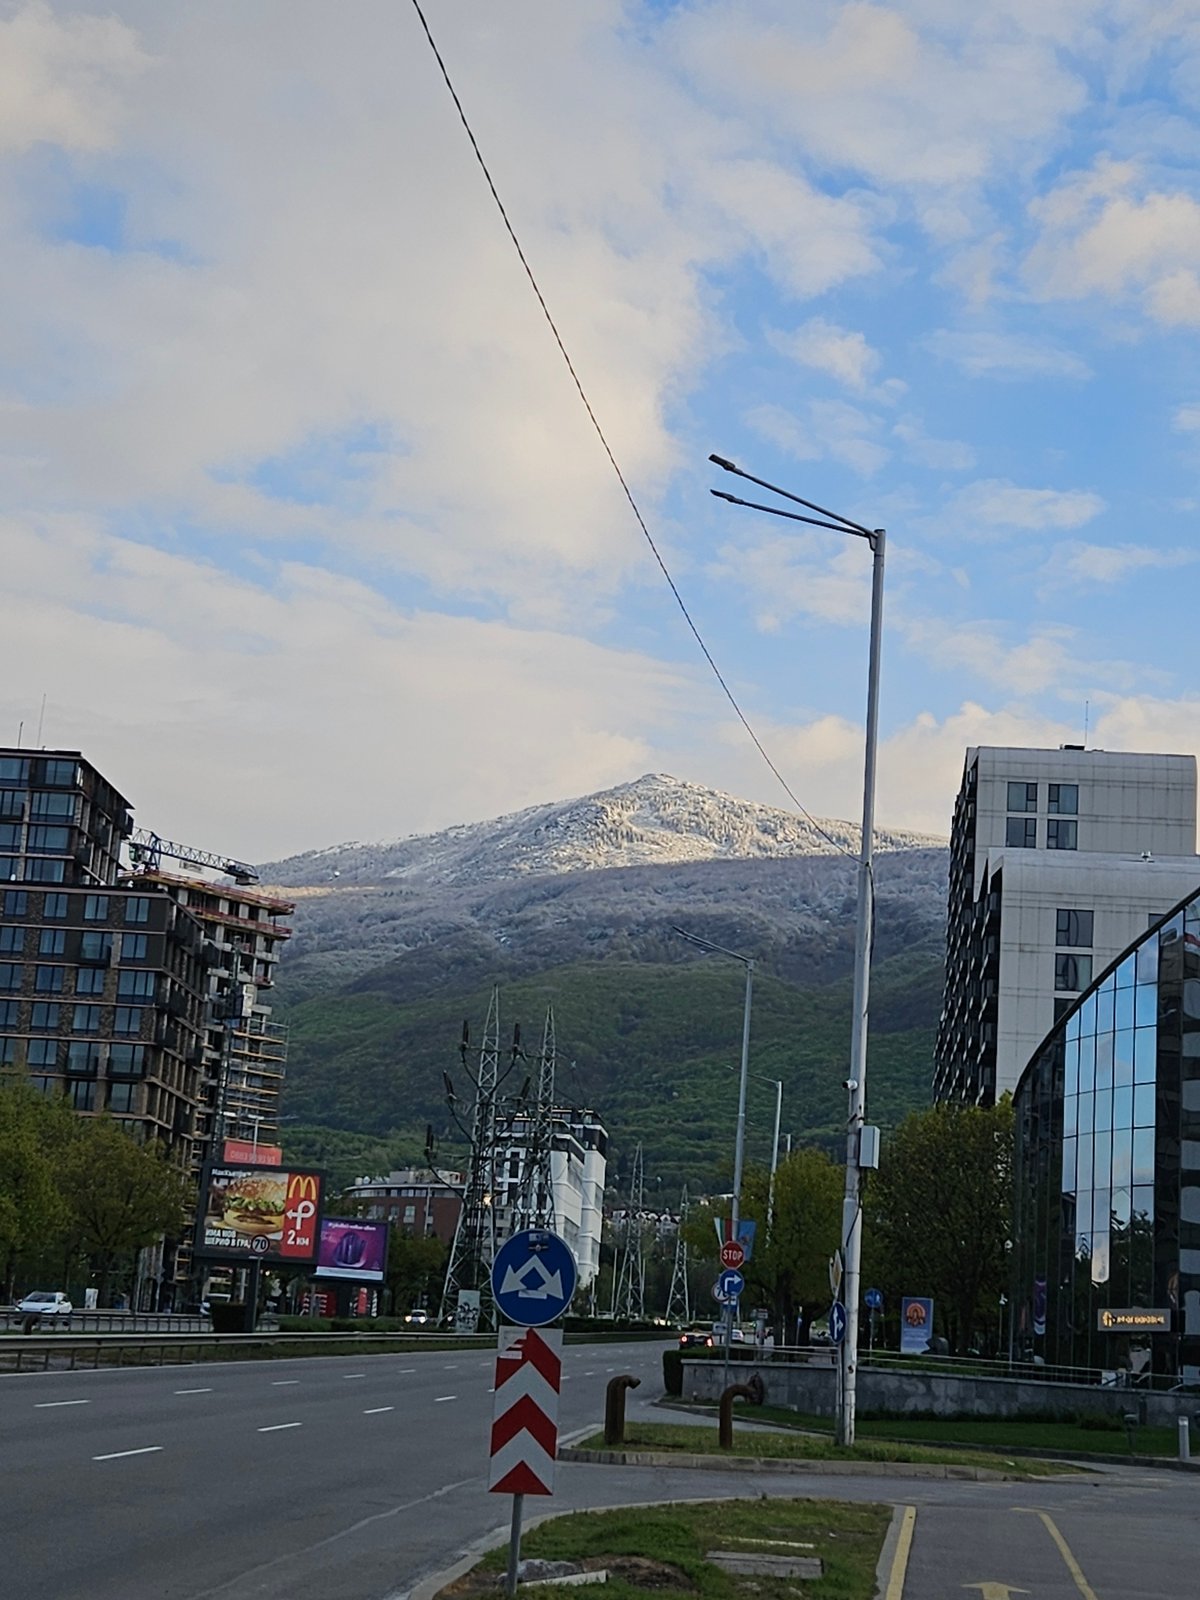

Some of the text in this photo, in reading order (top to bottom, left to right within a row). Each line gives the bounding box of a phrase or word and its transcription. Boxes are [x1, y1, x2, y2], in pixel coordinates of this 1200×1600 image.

[287, 1229, 296, 1245] 2
[254, 1239, 267, 1250] 70
[722, 1249, 743, 1261] STOP
